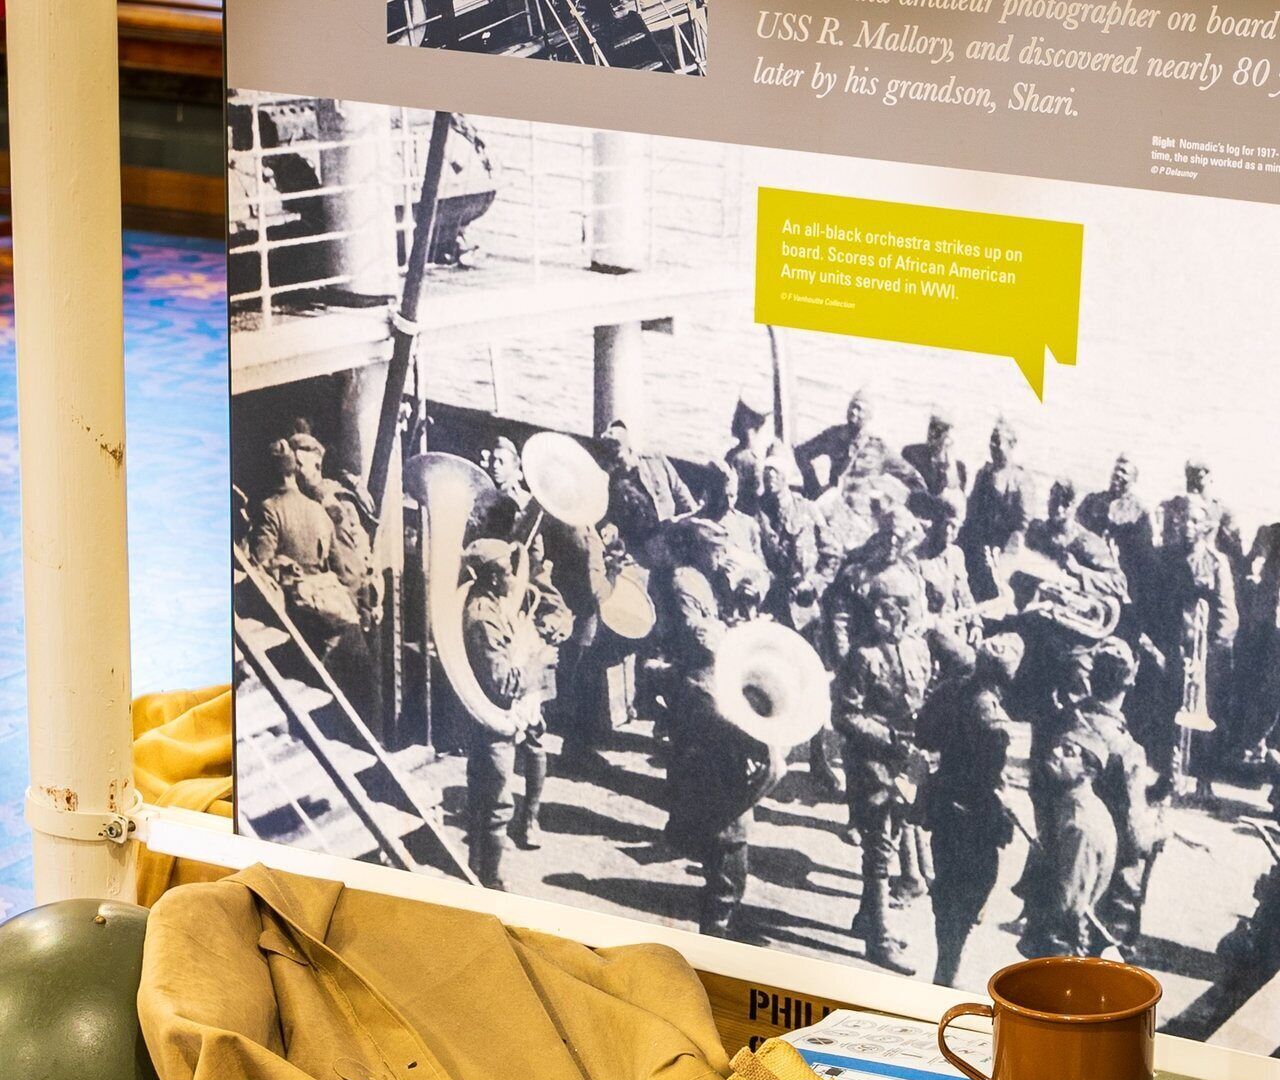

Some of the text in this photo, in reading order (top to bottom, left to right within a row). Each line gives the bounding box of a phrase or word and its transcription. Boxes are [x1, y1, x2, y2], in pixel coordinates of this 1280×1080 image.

[997, 0, 1161, 33] photographer
[1167, 15, 1196, 32] on
[1206, 5, 1280, 40] board
[756, 10, 812, 42] USS
[816, 16, 844, 46] R.
[853, 20, 955, 65] Mallory,
[965, 35, 1015, 63] and
[1018, 35, 1142, 75] discovered
[1147, 53, 1223, 91] nearly
[1232, 57, 1270, 87] 80
[753, 56, 1079, 117] later by his grandson, Shari.
[1151, 150, 1173, 163] time,
[1174, 152, 1188, 163] the
[1190, 154, 1208, 167] ship
[1210, 156, 1243, 170] worked
[1244, 161, 1256, 171] as
[1257, 162, 1263, 171] a
[1152, 135, 1176, 149] Right
[1179, 139, 1224, 154] Nomadic's
[1226, 143, 1240, 156] log
[1242, 145, 1254, 157] for
[781, 219, 1023, 262] An all-black orchestra strikes up on
[780, 263, 959, 300] Army units served in WWI.
[781, 240, 1016, 284] board. Scores of African American
[824, 297, 856, 309] Collection
